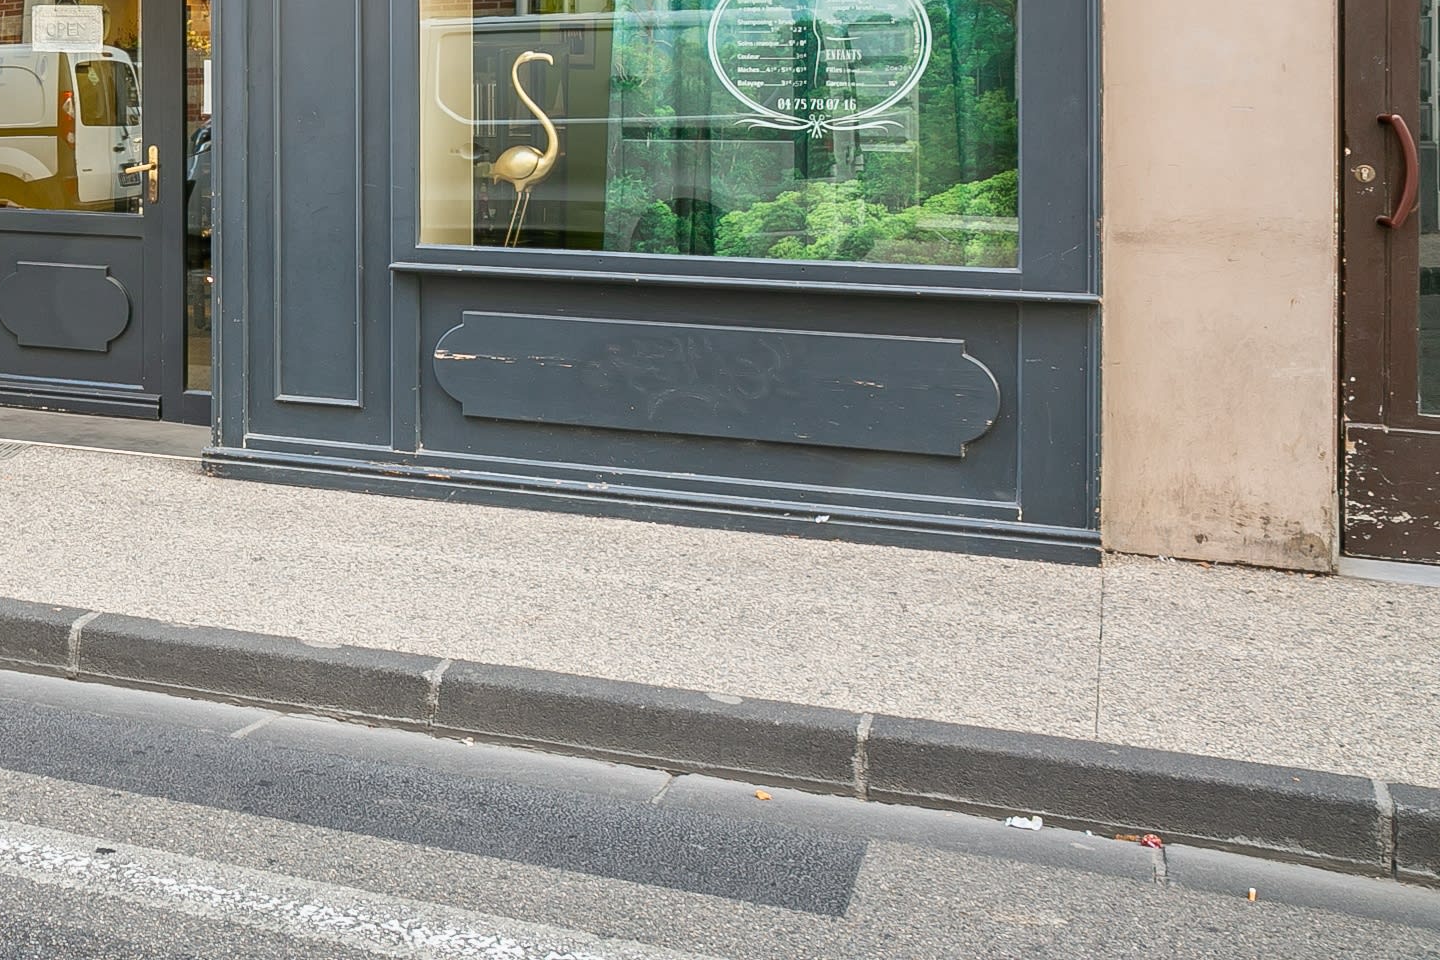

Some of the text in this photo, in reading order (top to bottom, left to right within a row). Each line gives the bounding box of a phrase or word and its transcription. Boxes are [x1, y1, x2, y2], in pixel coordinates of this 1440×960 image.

[47, 22, 86, 37] OPEN
[825, 48, 862, 60] ENFANTS
[777, 98, 857, 110] 04 75 78 07 16
